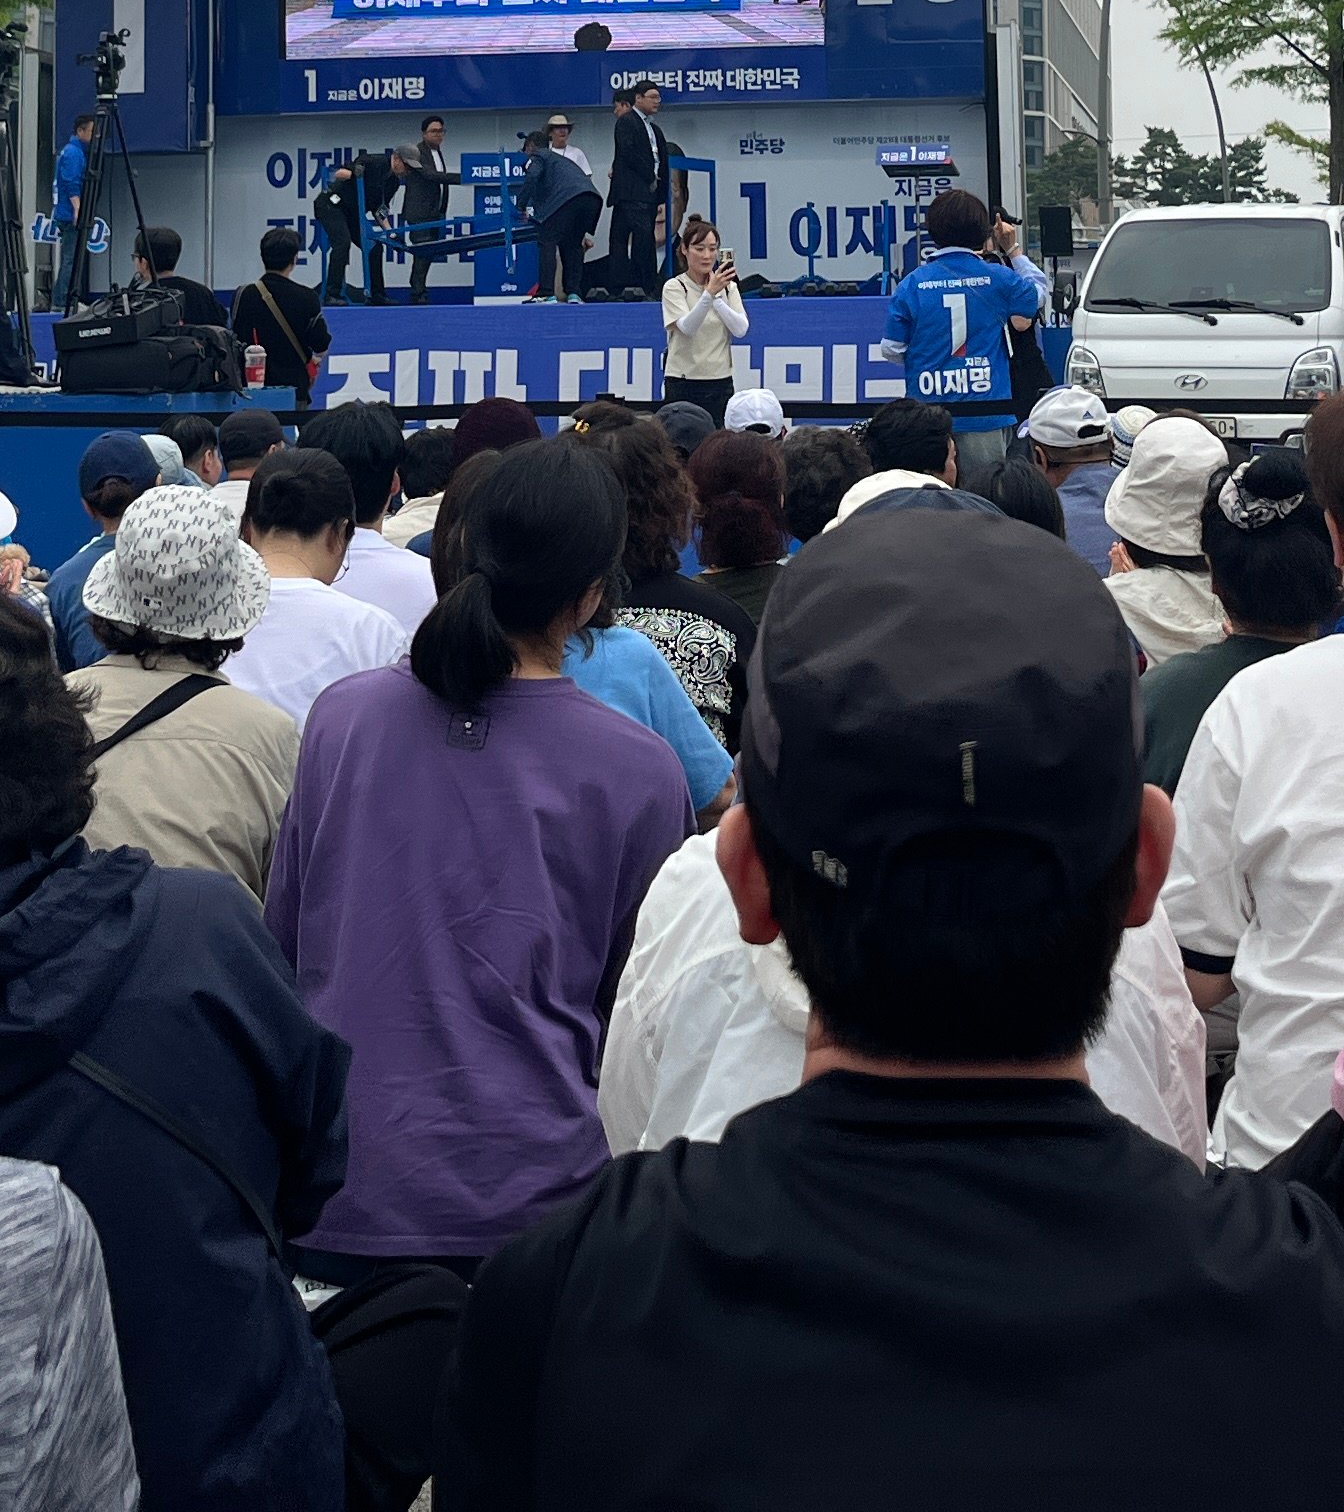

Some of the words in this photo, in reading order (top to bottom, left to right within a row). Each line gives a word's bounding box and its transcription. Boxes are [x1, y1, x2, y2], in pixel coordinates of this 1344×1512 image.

[304, 69, 317, 102] 1
[327, 89, 357, 101] 지금은
[359, 77, 425, 100] 이재명
[610, 69, 683, 92] 이제부터
[686, 69, 723, 92] 진짜
[726, 68, 801, 91] 대한민국
[739, 138, 785, 155] 민주당
[881, 152, 908, 162] 지금은
[471, 166, 501, 178] 지금은
[894, 177, 953, 197] 지금은
[739, 182, 768, 260] 1
[943, 293, 968, 357] 1
[919, 367, 992, 396] 이재명
